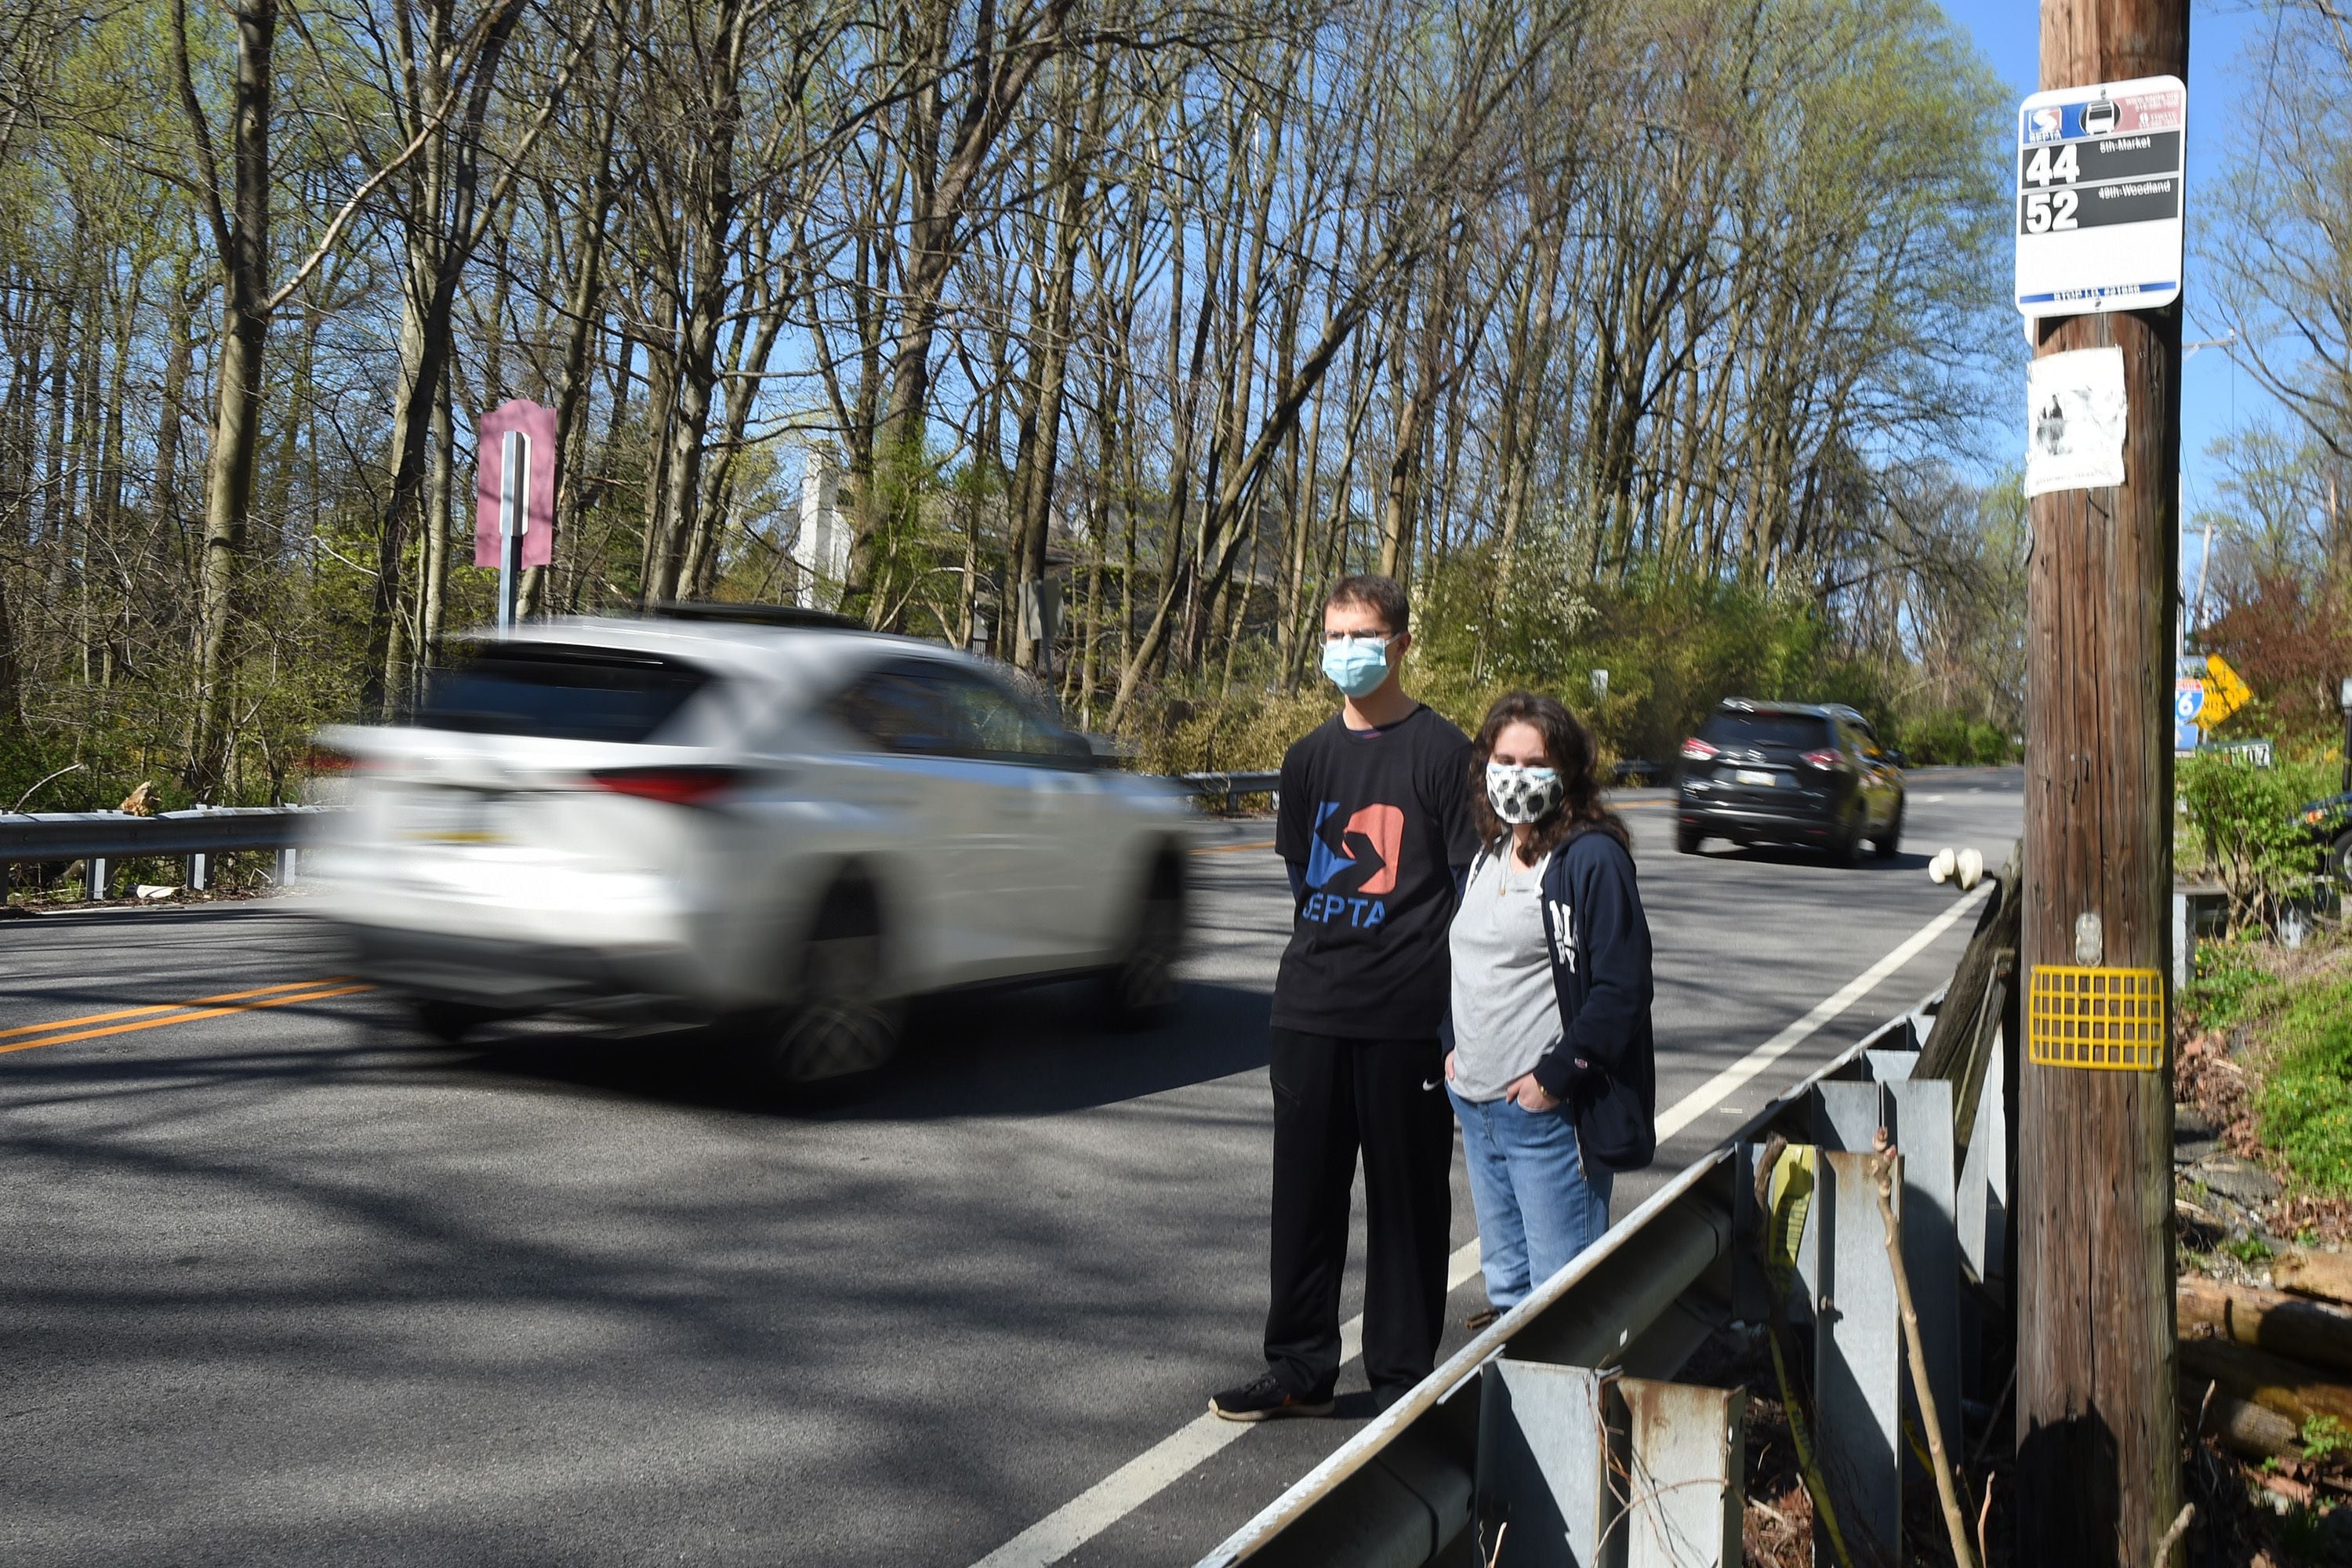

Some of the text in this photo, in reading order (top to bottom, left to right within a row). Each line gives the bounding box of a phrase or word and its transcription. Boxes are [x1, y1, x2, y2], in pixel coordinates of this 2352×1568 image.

[2029, 130, 2062, 143] SEPTA
[2026, 143, 2080, 187] 44
[2026, 190, 2078, 234] 52
[2175, 691, 2194, 717] 6
[1302, 892, 1386, 928] SEPTA
